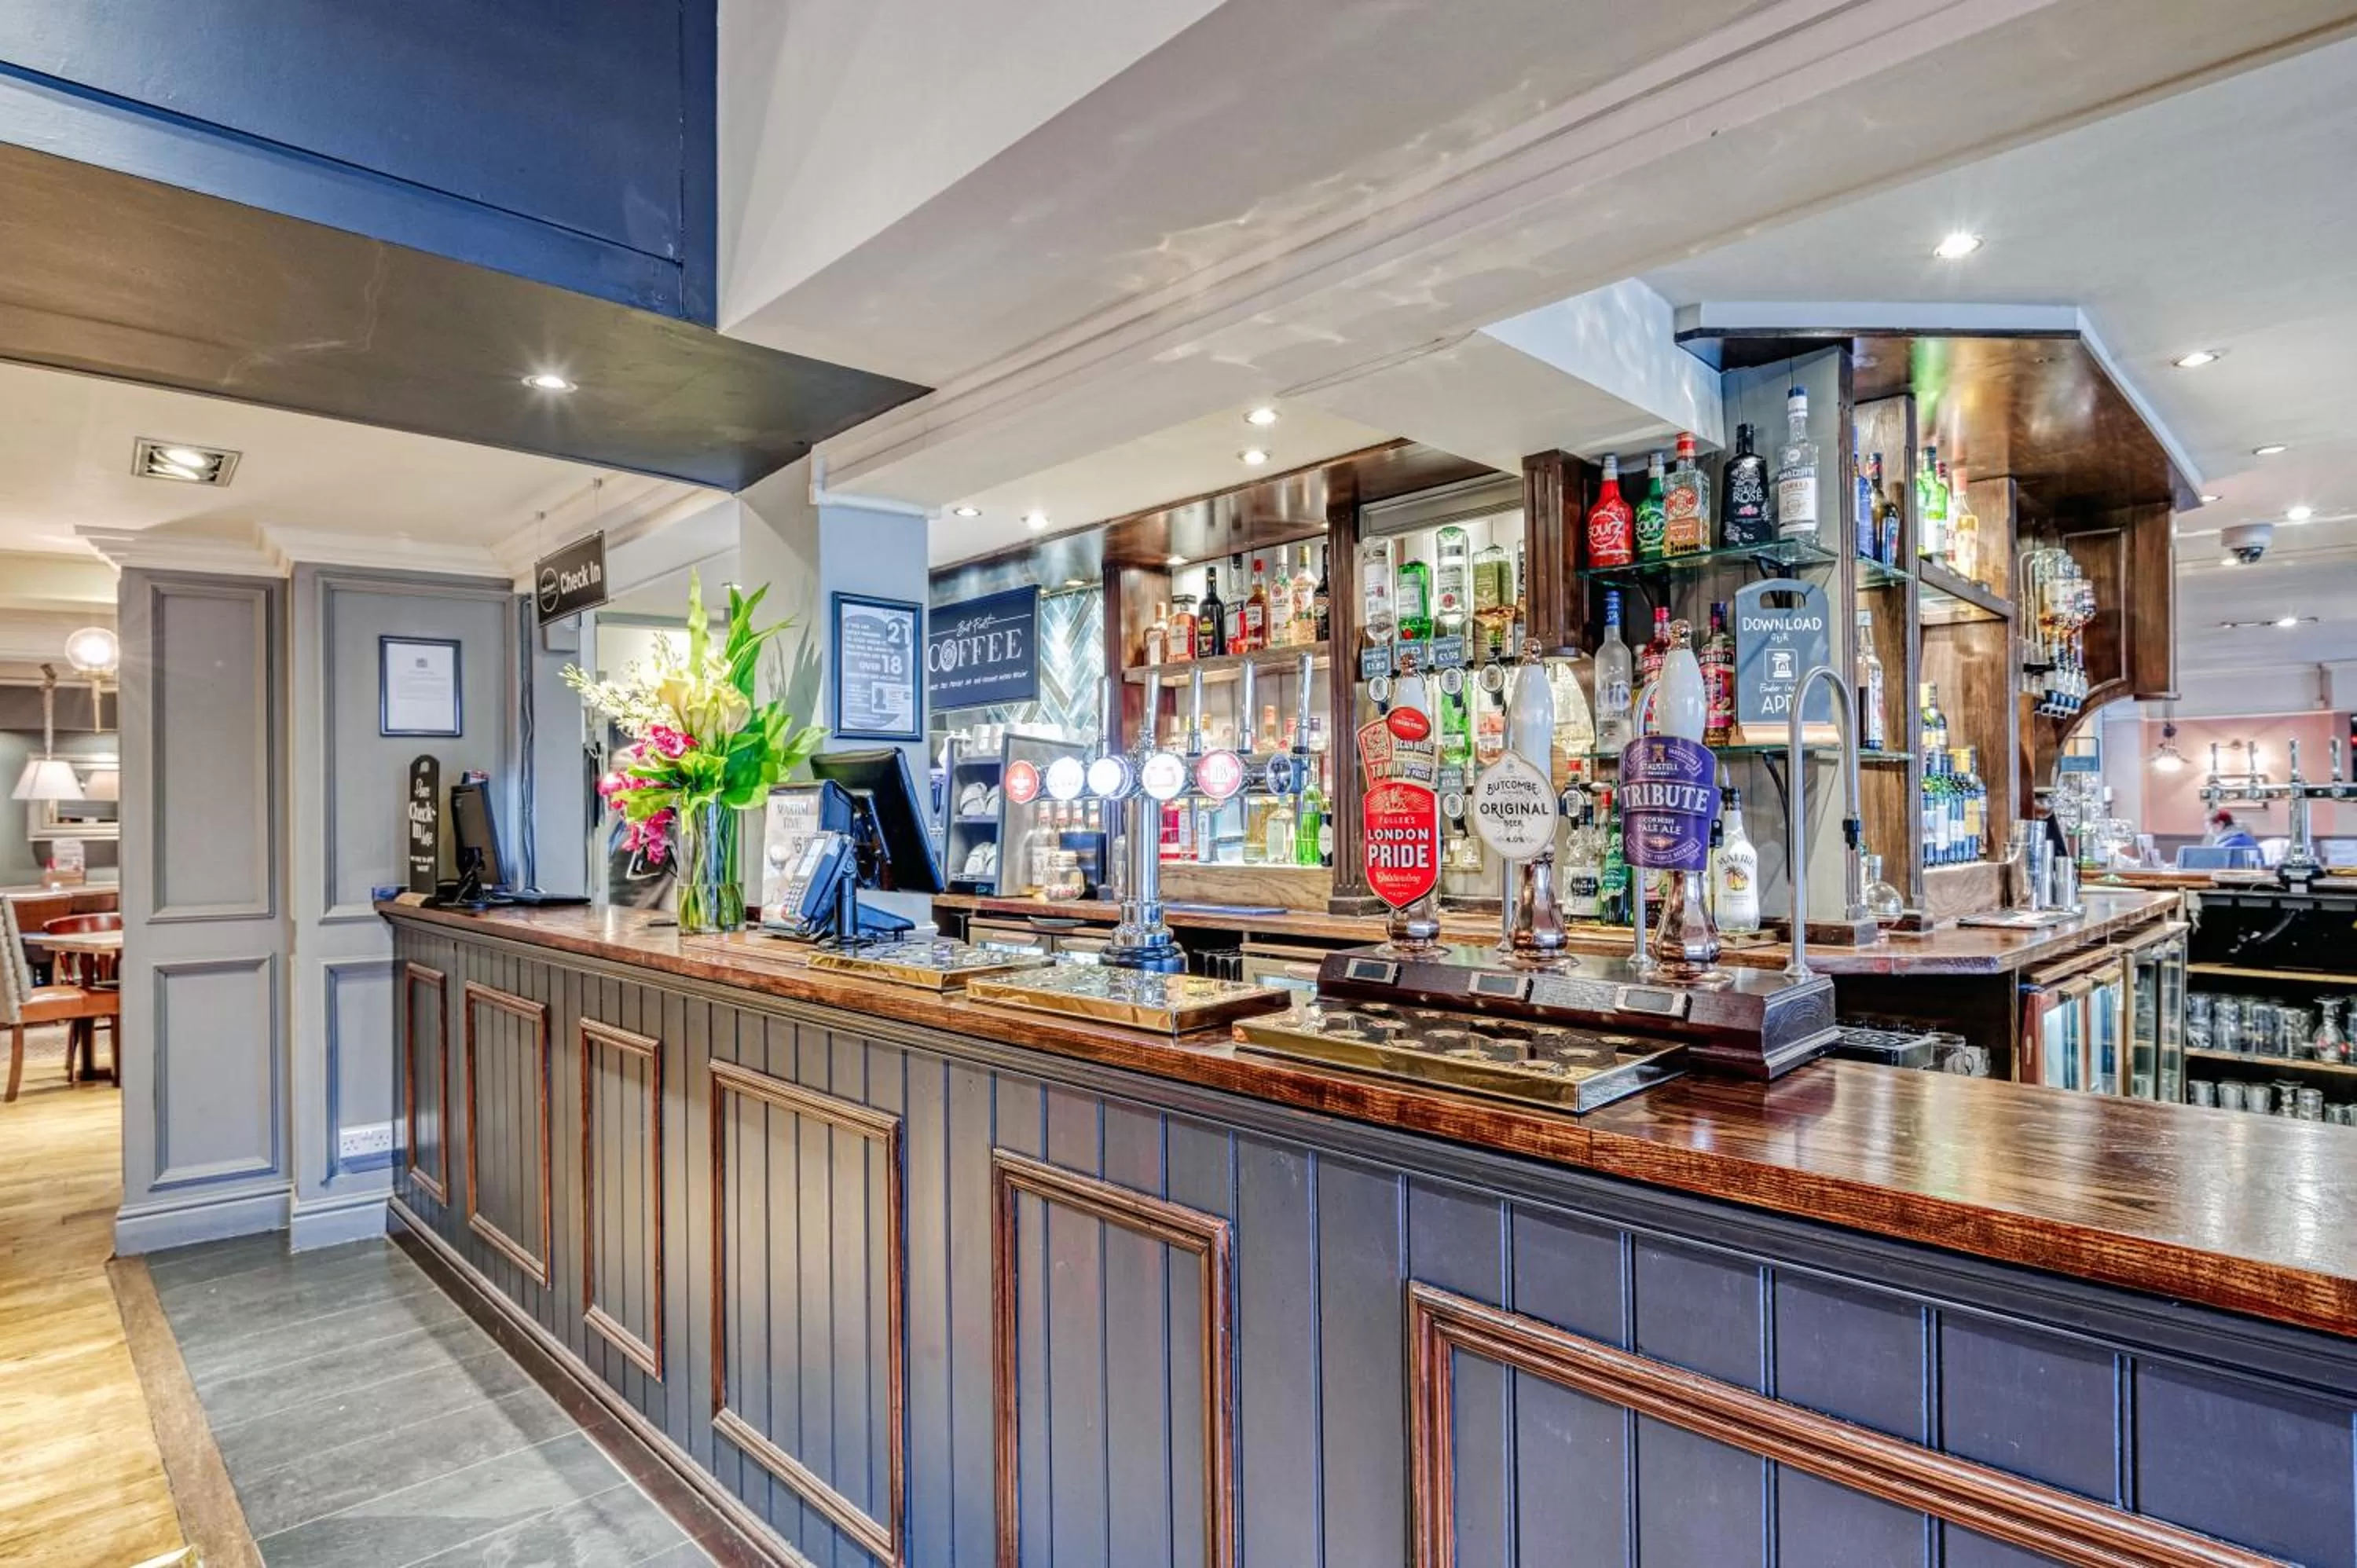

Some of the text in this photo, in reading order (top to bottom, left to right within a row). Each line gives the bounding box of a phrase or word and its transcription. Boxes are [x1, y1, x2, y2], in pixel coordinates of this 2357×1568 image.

[1732, 492, 1764, 503] ROSE
[560, 565, 589, 595] Check
[589, 560, 601, 584] In
[887, 621, 911, 644] 21
[1742, 617, 1823, 632] DOWNLOAD
[1770, 632, 1789, 644] OUR
[928, 628, 1022, 672] COFFEE
[882, 654, 903, 675] 18
[1486, 780, 1539, 796] BUTCOMBE
[1622, 784, 1710, 813] TRIBUTE
[1479, 802, 1549, 819] ORIGINAL
[1367, 829, 1430, 841] LONDON
[1661, 825, 1682, 835] ALE
[1368, 844, 1430, 868] PRIDE
